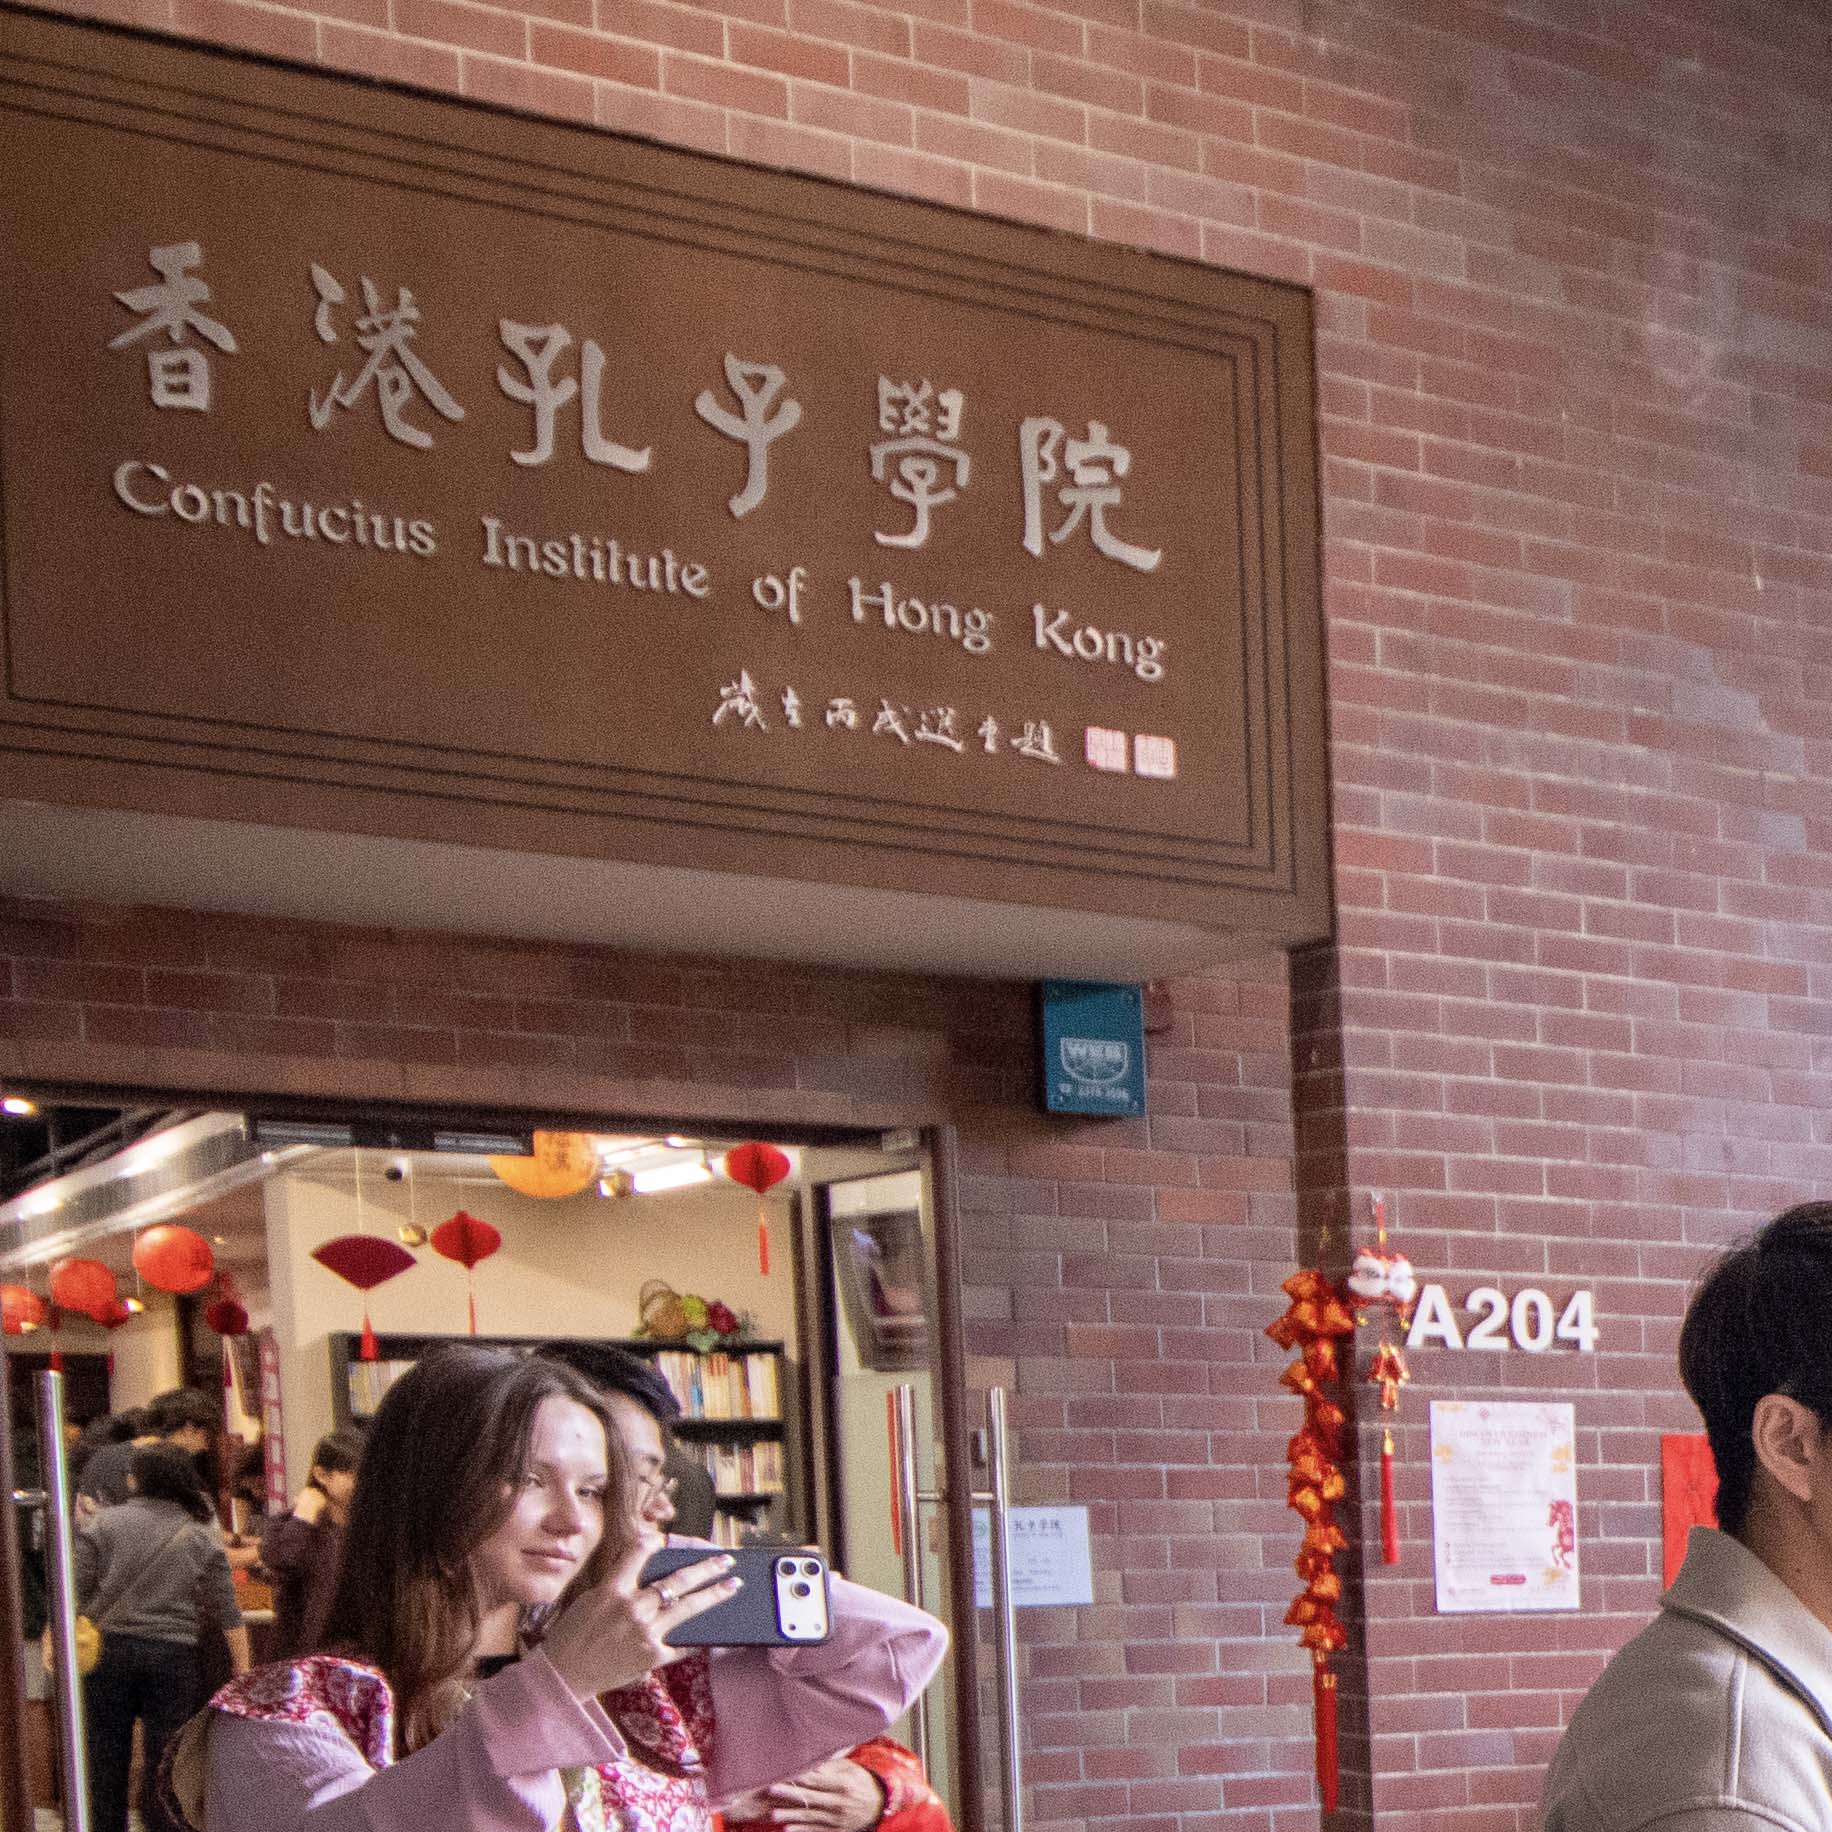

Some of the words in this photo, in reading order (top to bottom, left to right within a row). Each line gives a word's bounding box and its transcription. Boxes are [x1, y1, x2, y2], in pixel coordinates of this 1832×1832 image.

[109, 241, 1162, 571] 香港孔子學院
[114, 460, 437, 556] Confucius
[480, 514, 710, 598] Institute
[752, 565, 807, 624] of
[847, 575, 994, 654] Hong
[1032, 602, 1165, 682] Kong
[1406, 1284, 1599, 1353] A204
